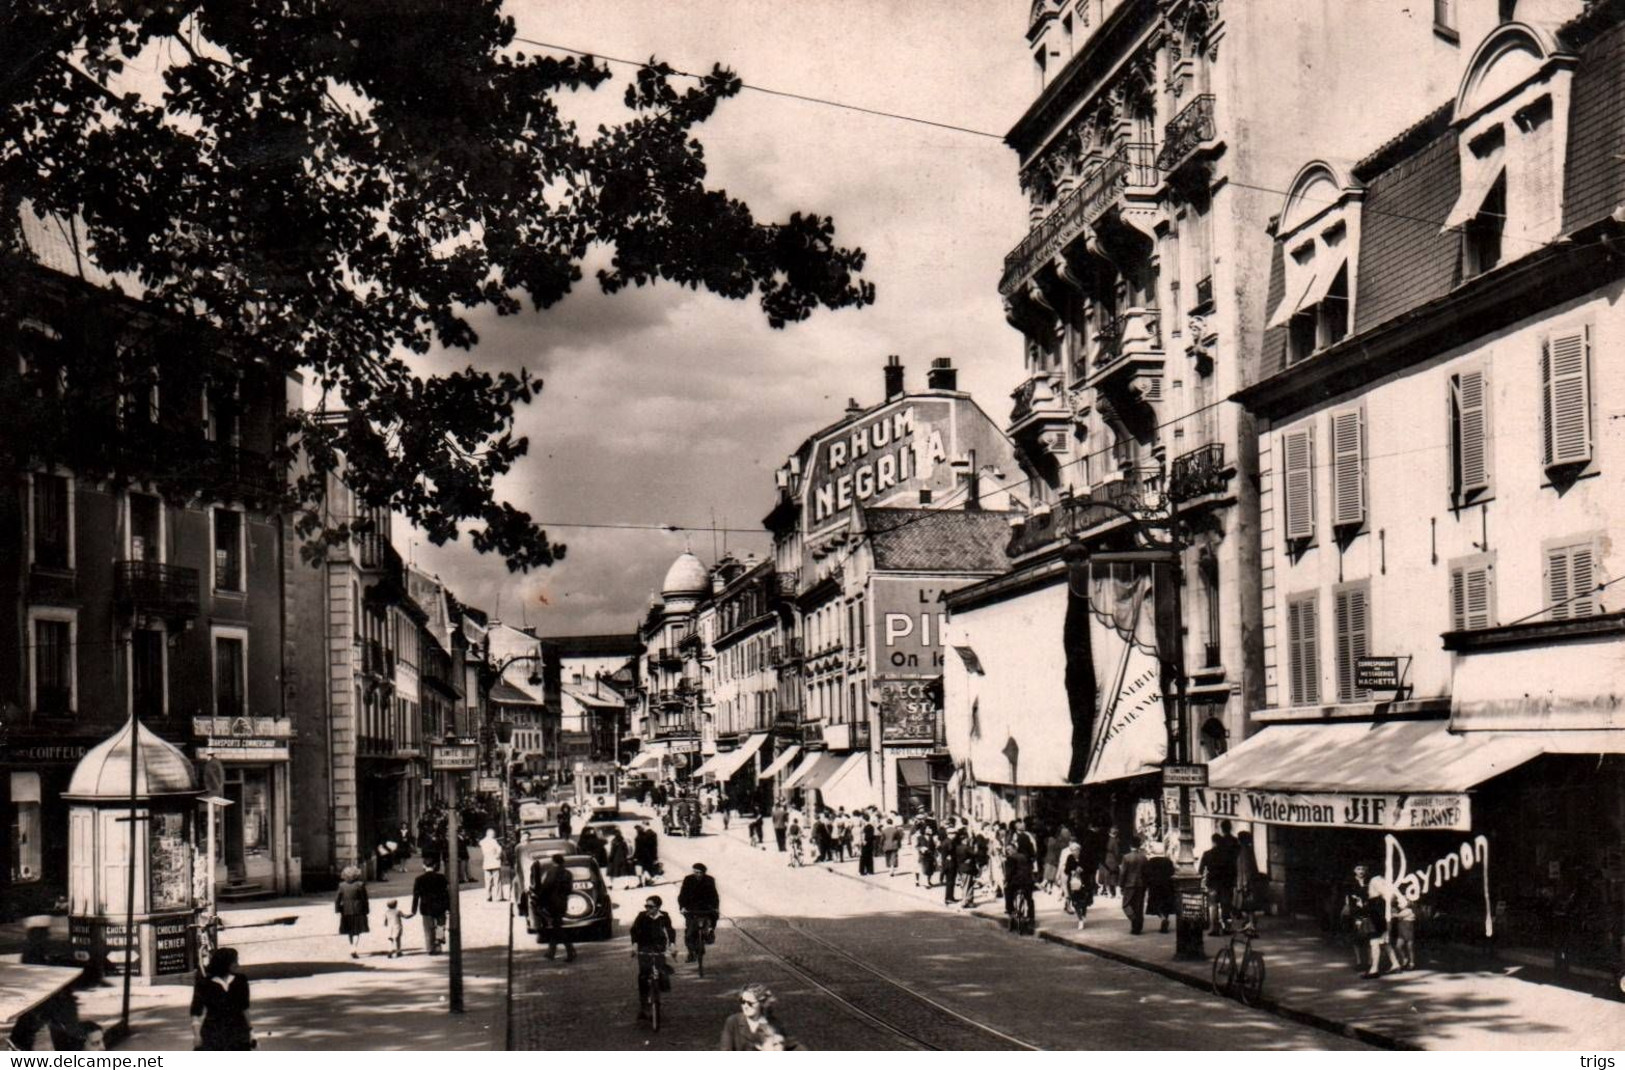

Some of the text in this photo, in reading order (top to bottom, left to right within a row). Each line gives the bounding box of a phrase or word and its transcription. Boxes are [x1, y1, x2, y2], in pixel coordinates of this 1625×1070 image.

[829, 406, 914, 470] RHUM
[815, 429, 946, 521] NEGRITA
[890, 651, 919, 667] On
[1211, 792, 1240, 816] JiF
[1247, 794, 1335, 823] Waterman
[1344, 798, 1386, 825] JiF
[157, 938, 186, 950] MENIER
